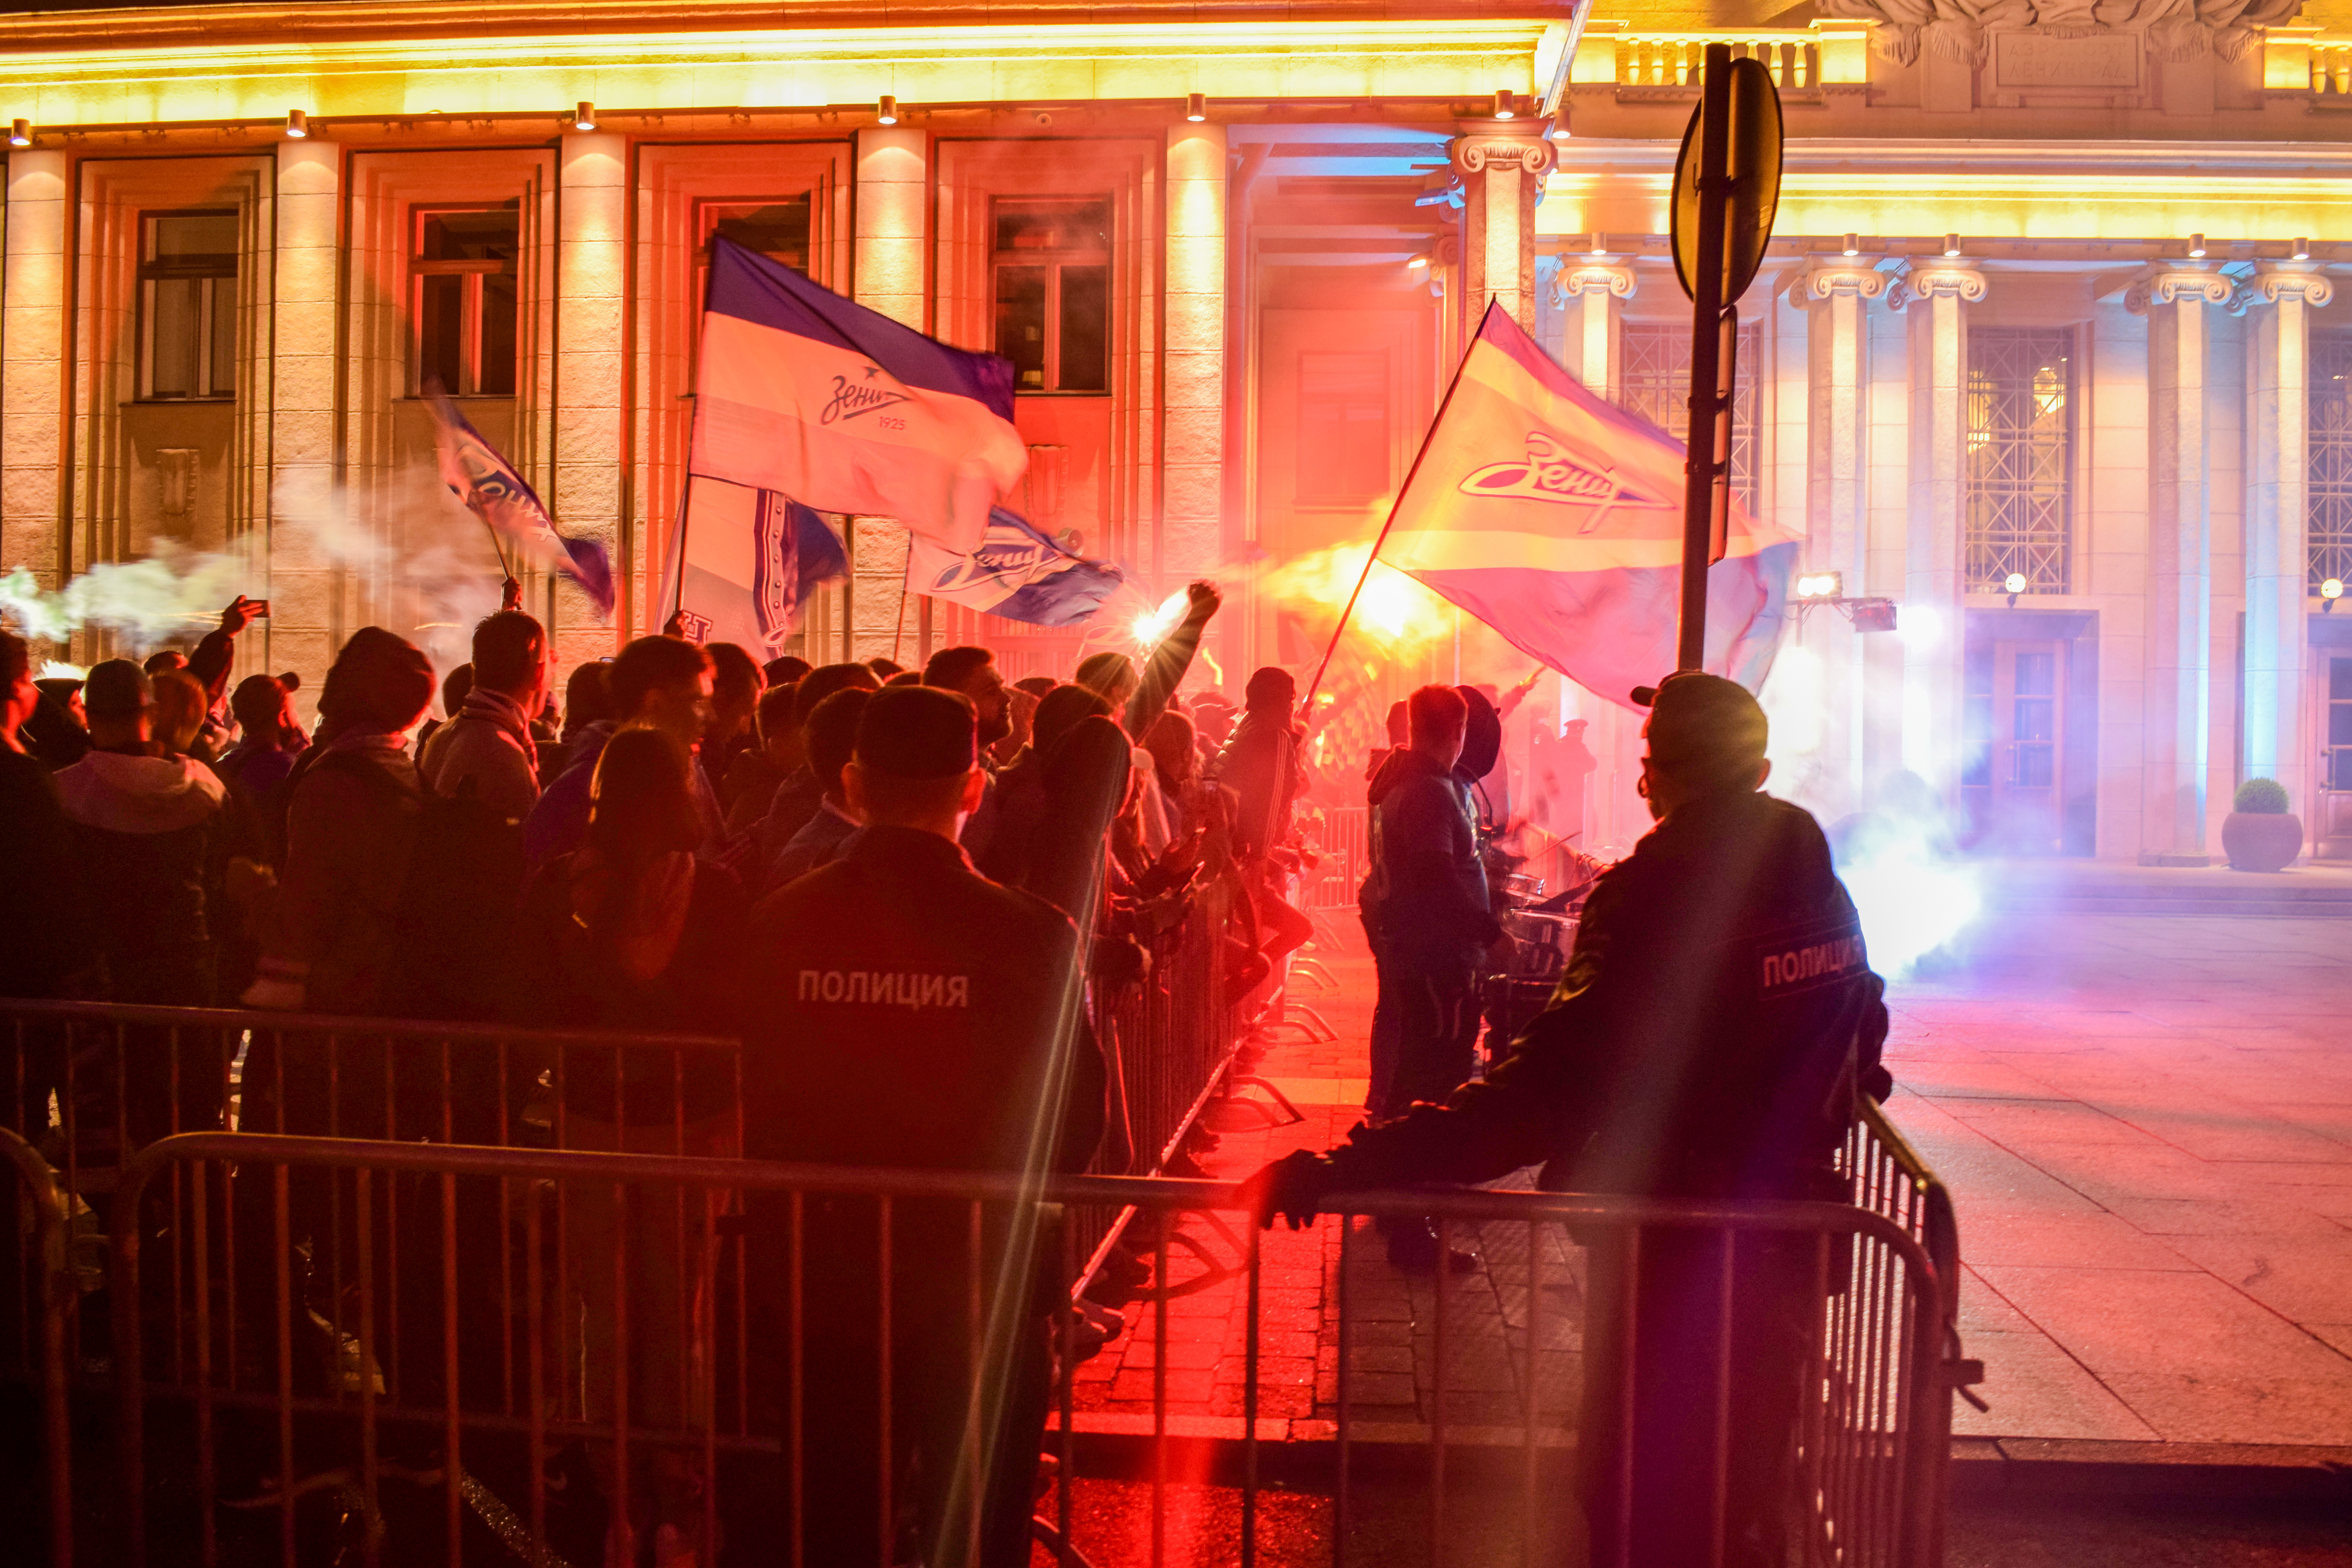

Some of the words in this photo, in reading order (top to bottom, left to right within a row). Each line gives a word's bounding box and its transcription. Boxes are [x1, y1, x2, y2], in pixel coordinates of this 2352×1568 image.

[2009, 42, 2127, 56] АЭРОПОРТ
[2009, 61, 2128, 78] ЛЕНИНГРАД
[878, 416, 906, 430] 1925
[1457, 430, 1681, 535] Зенит
[798, 970, 968, 1011] ПОЛИЦИЯ
